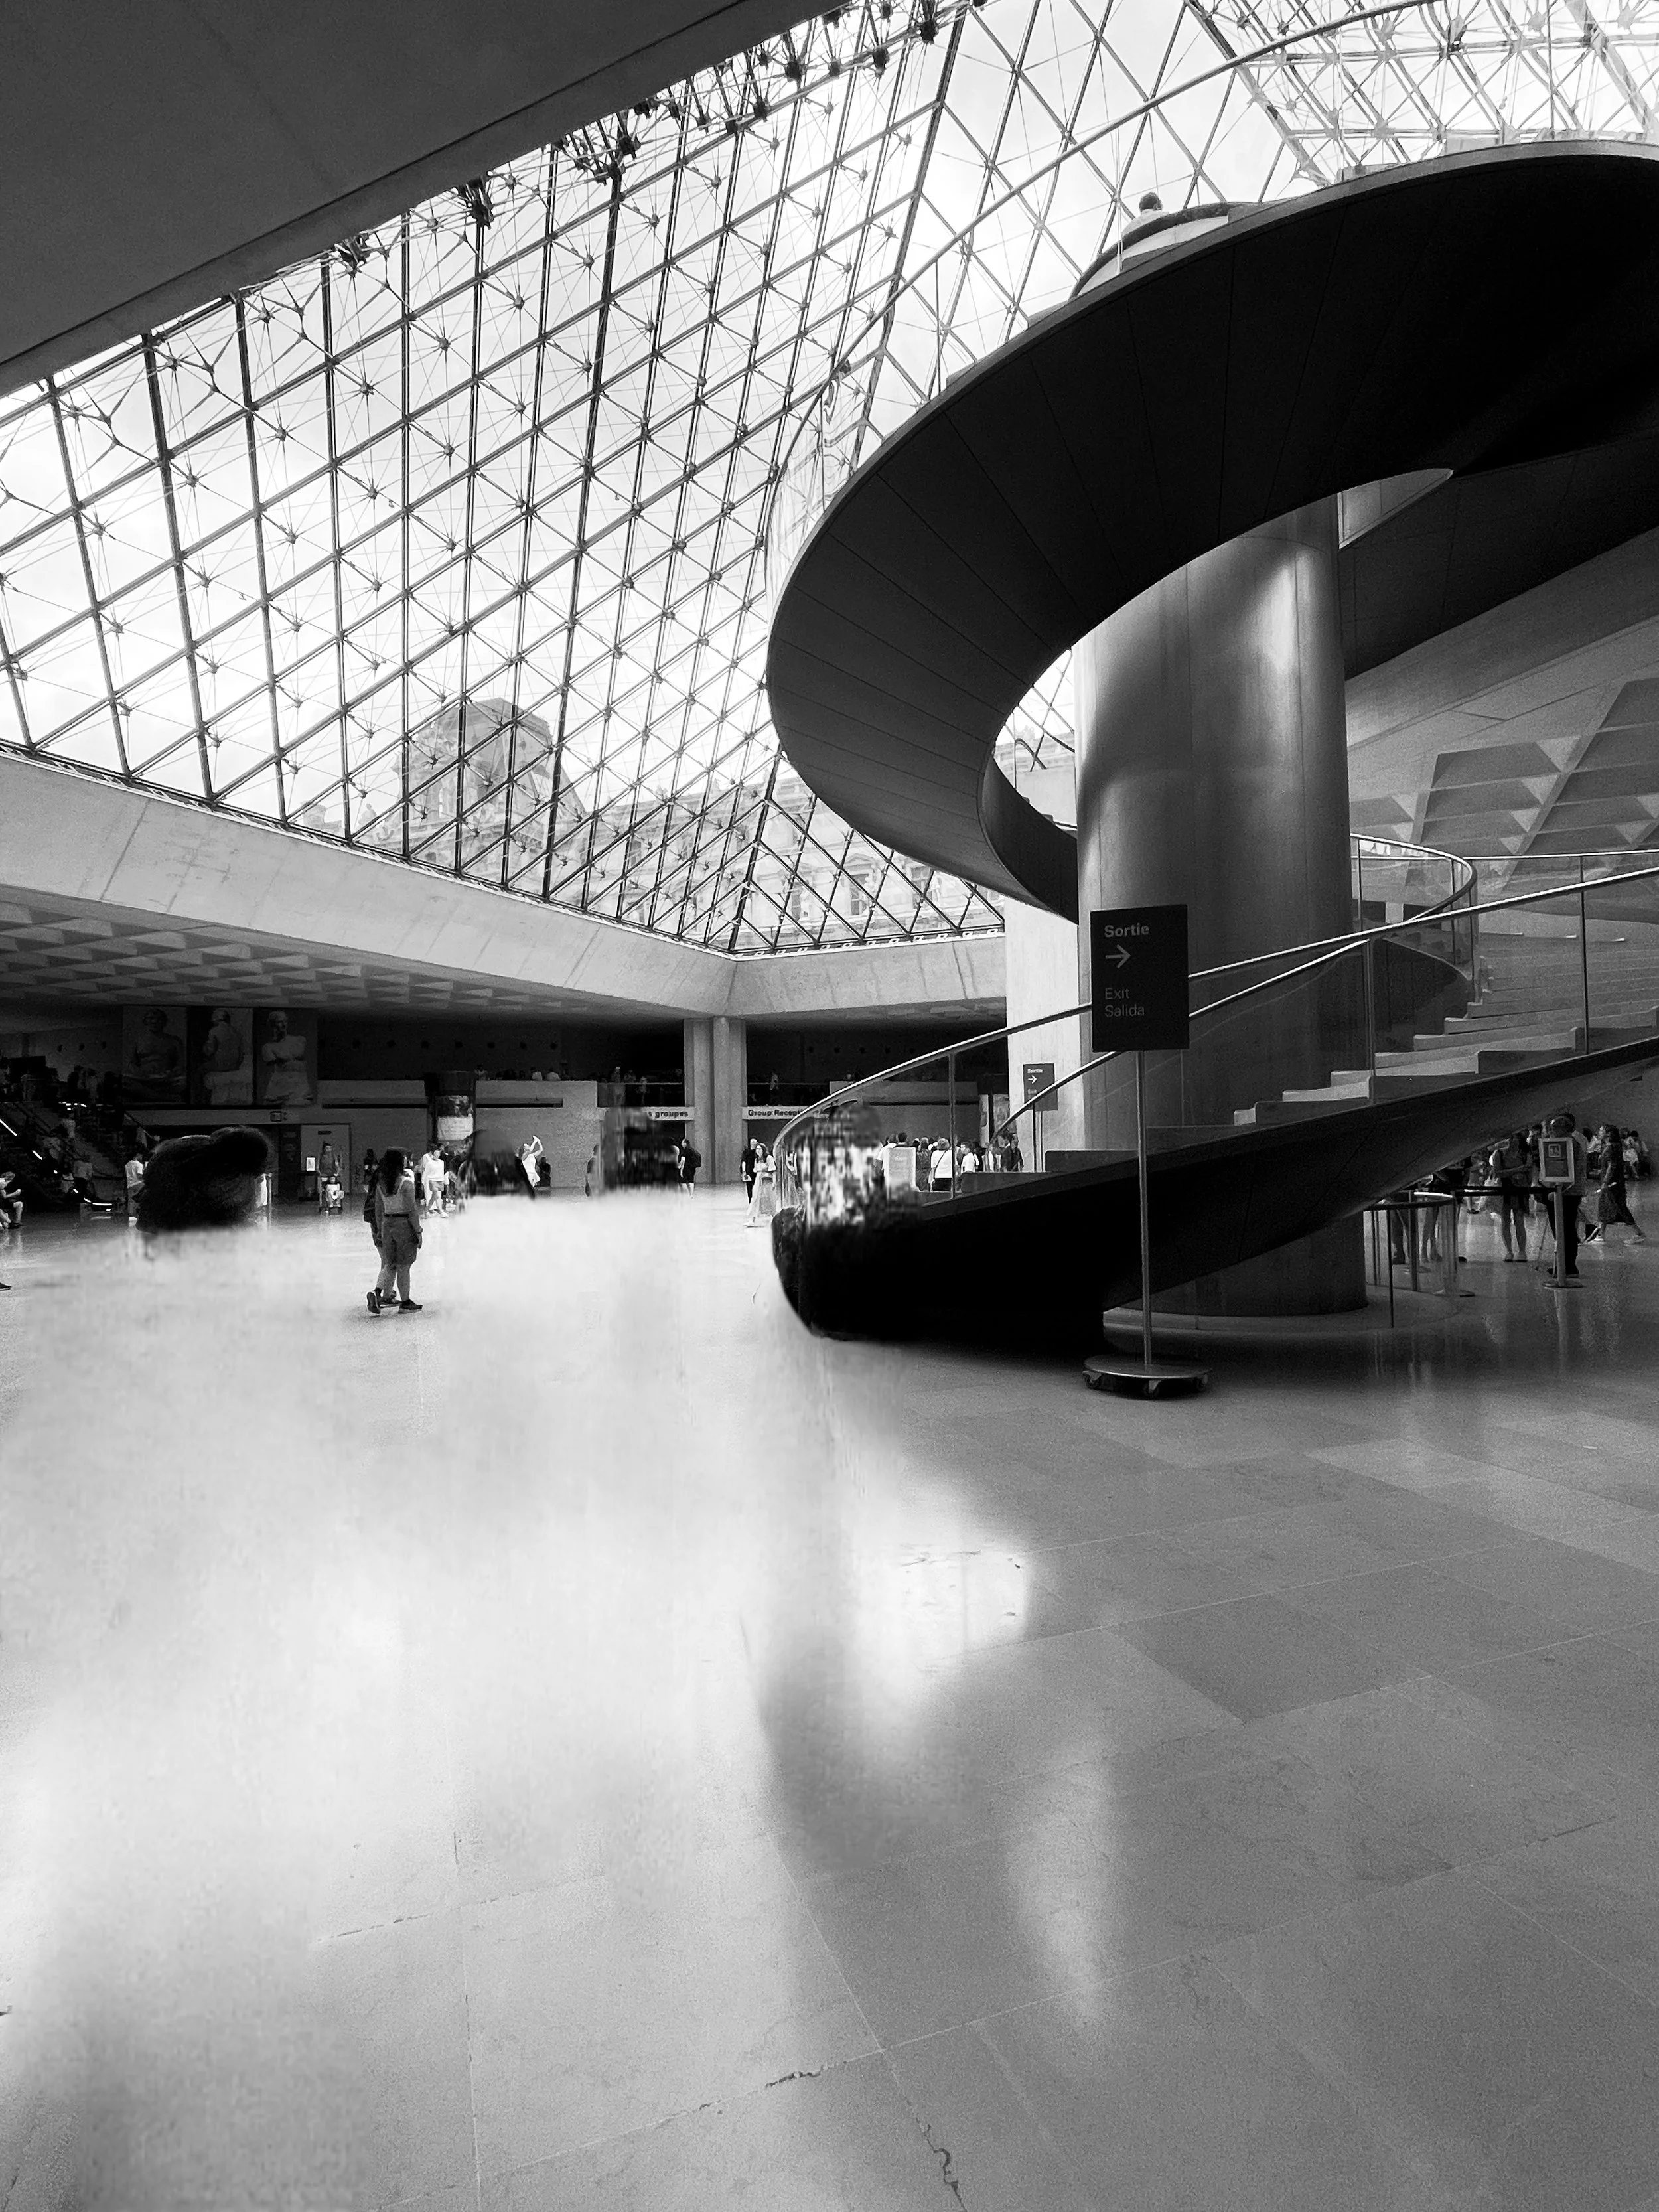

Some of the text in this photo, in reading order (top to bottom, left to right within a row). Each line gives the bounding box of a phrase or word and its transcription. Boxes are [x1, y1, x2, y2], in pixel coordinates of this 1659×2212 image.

[1104, 922, 1149, 938] Sortie
[1105, 987, 1130, 999] Exit
[1104, 1003, 1145, 1017] Salida
